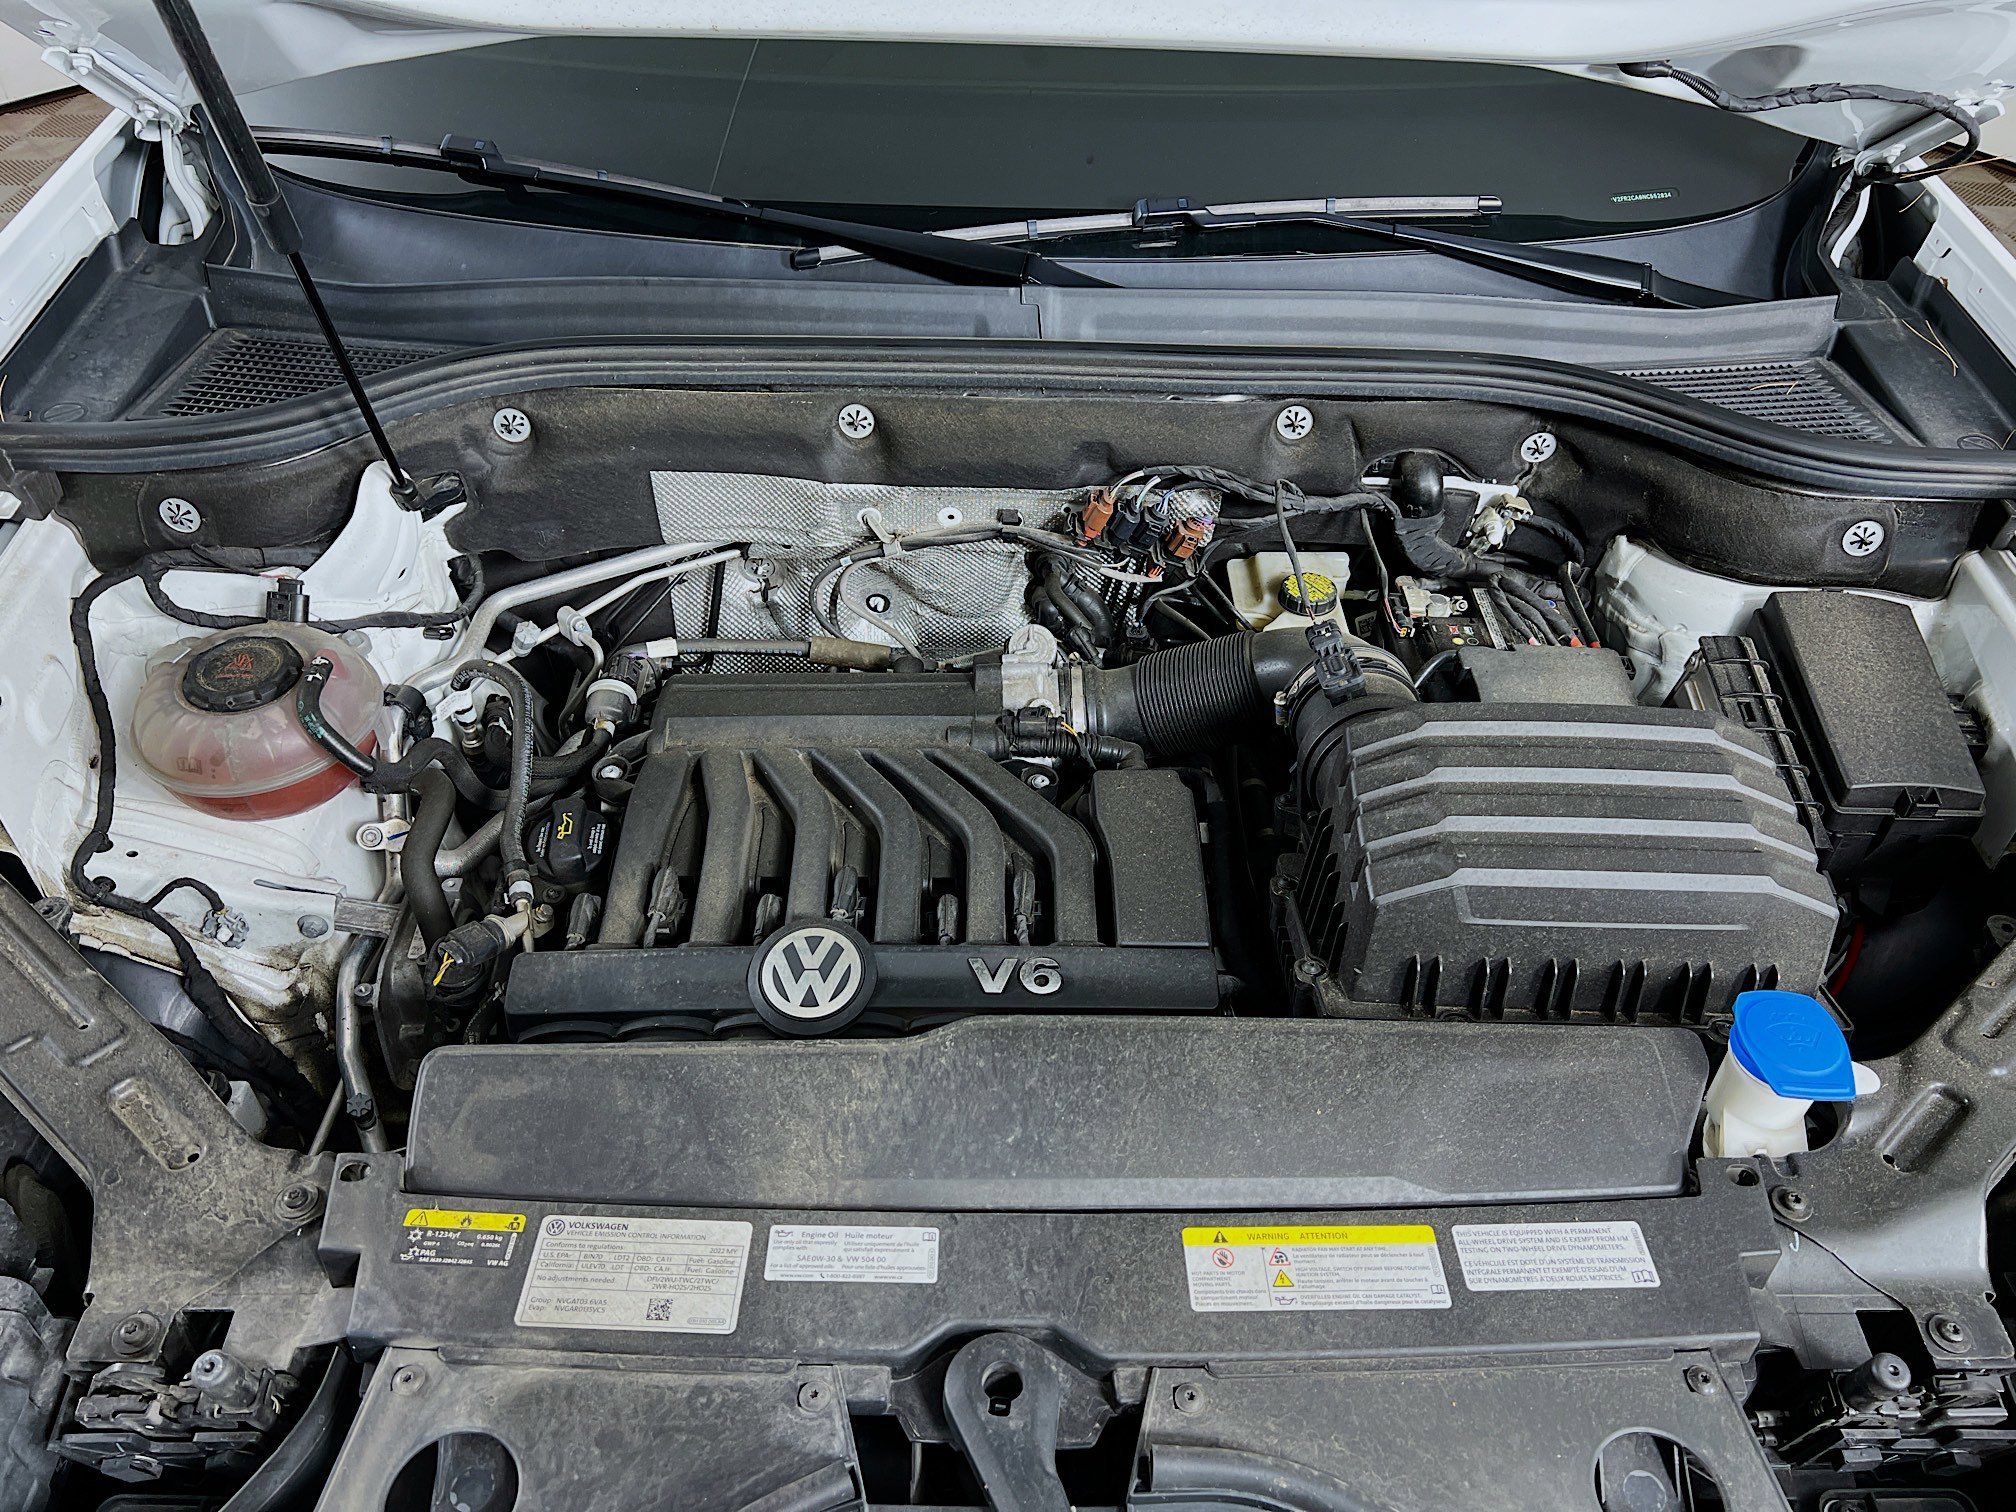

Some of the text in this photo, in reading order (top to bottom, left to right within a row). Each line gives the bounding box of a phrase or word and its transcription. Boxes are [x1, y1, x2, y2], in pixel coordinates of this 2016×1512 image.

[967, 957, 1062, 994] V6
[568, 1222, 629, 1231] VOLKSWAGEN
[426, 1230, 462, 1240] R-1234yf
[495, 1234, 504, 1242] kg
[1247, 1232, 1348, 1241] WARNING ATTENTION
[546, 1241, 577, 1249] Conforms
[548, 1275, 588, 1283] adjustments
